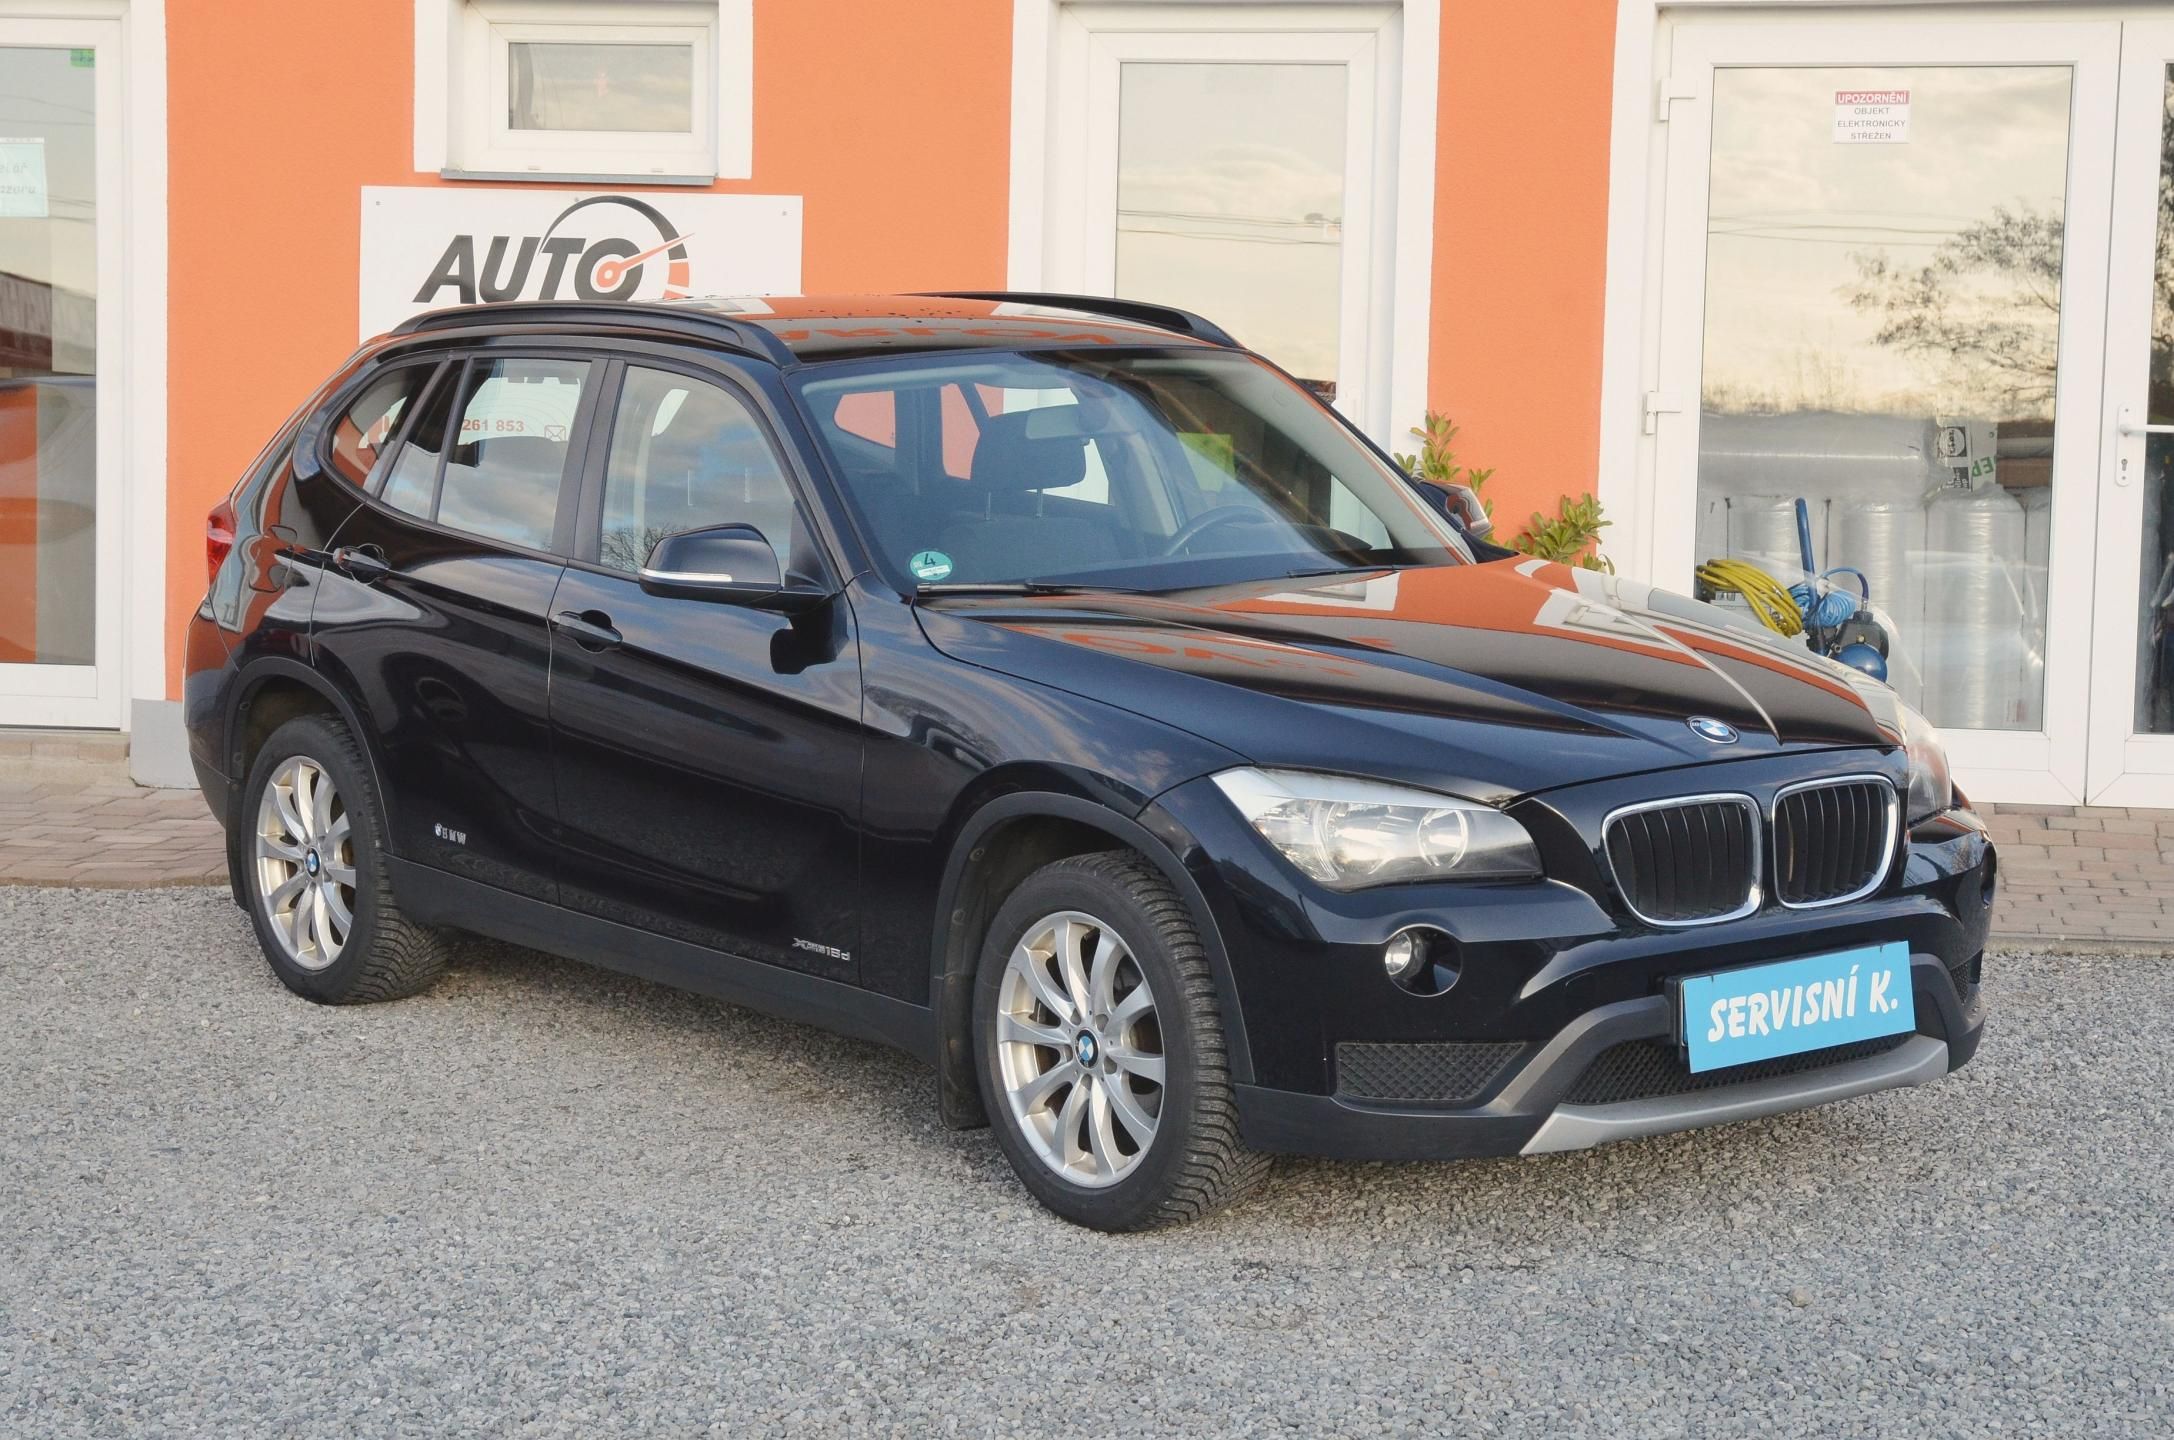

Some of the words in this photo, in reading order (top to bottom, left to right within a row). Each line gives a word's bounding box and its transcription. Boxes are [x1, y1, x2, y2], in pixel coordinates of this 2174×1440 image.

[1838, 91, 1907, 104] UPOZORNĚNÍ
[1854, 107, 1890, 115] OBJEKT
[412, 234, 644, 304] AUTO
[462, 419, 489, 432] 261
[496, 419, 525, 432] 853
[924, 553, 936, 565] 4
[442, 826, 467, 845] BMW
[1707, 964, 1860, 1042] SERVISNÍ
[1869, 970, 1899, 1014] K.
